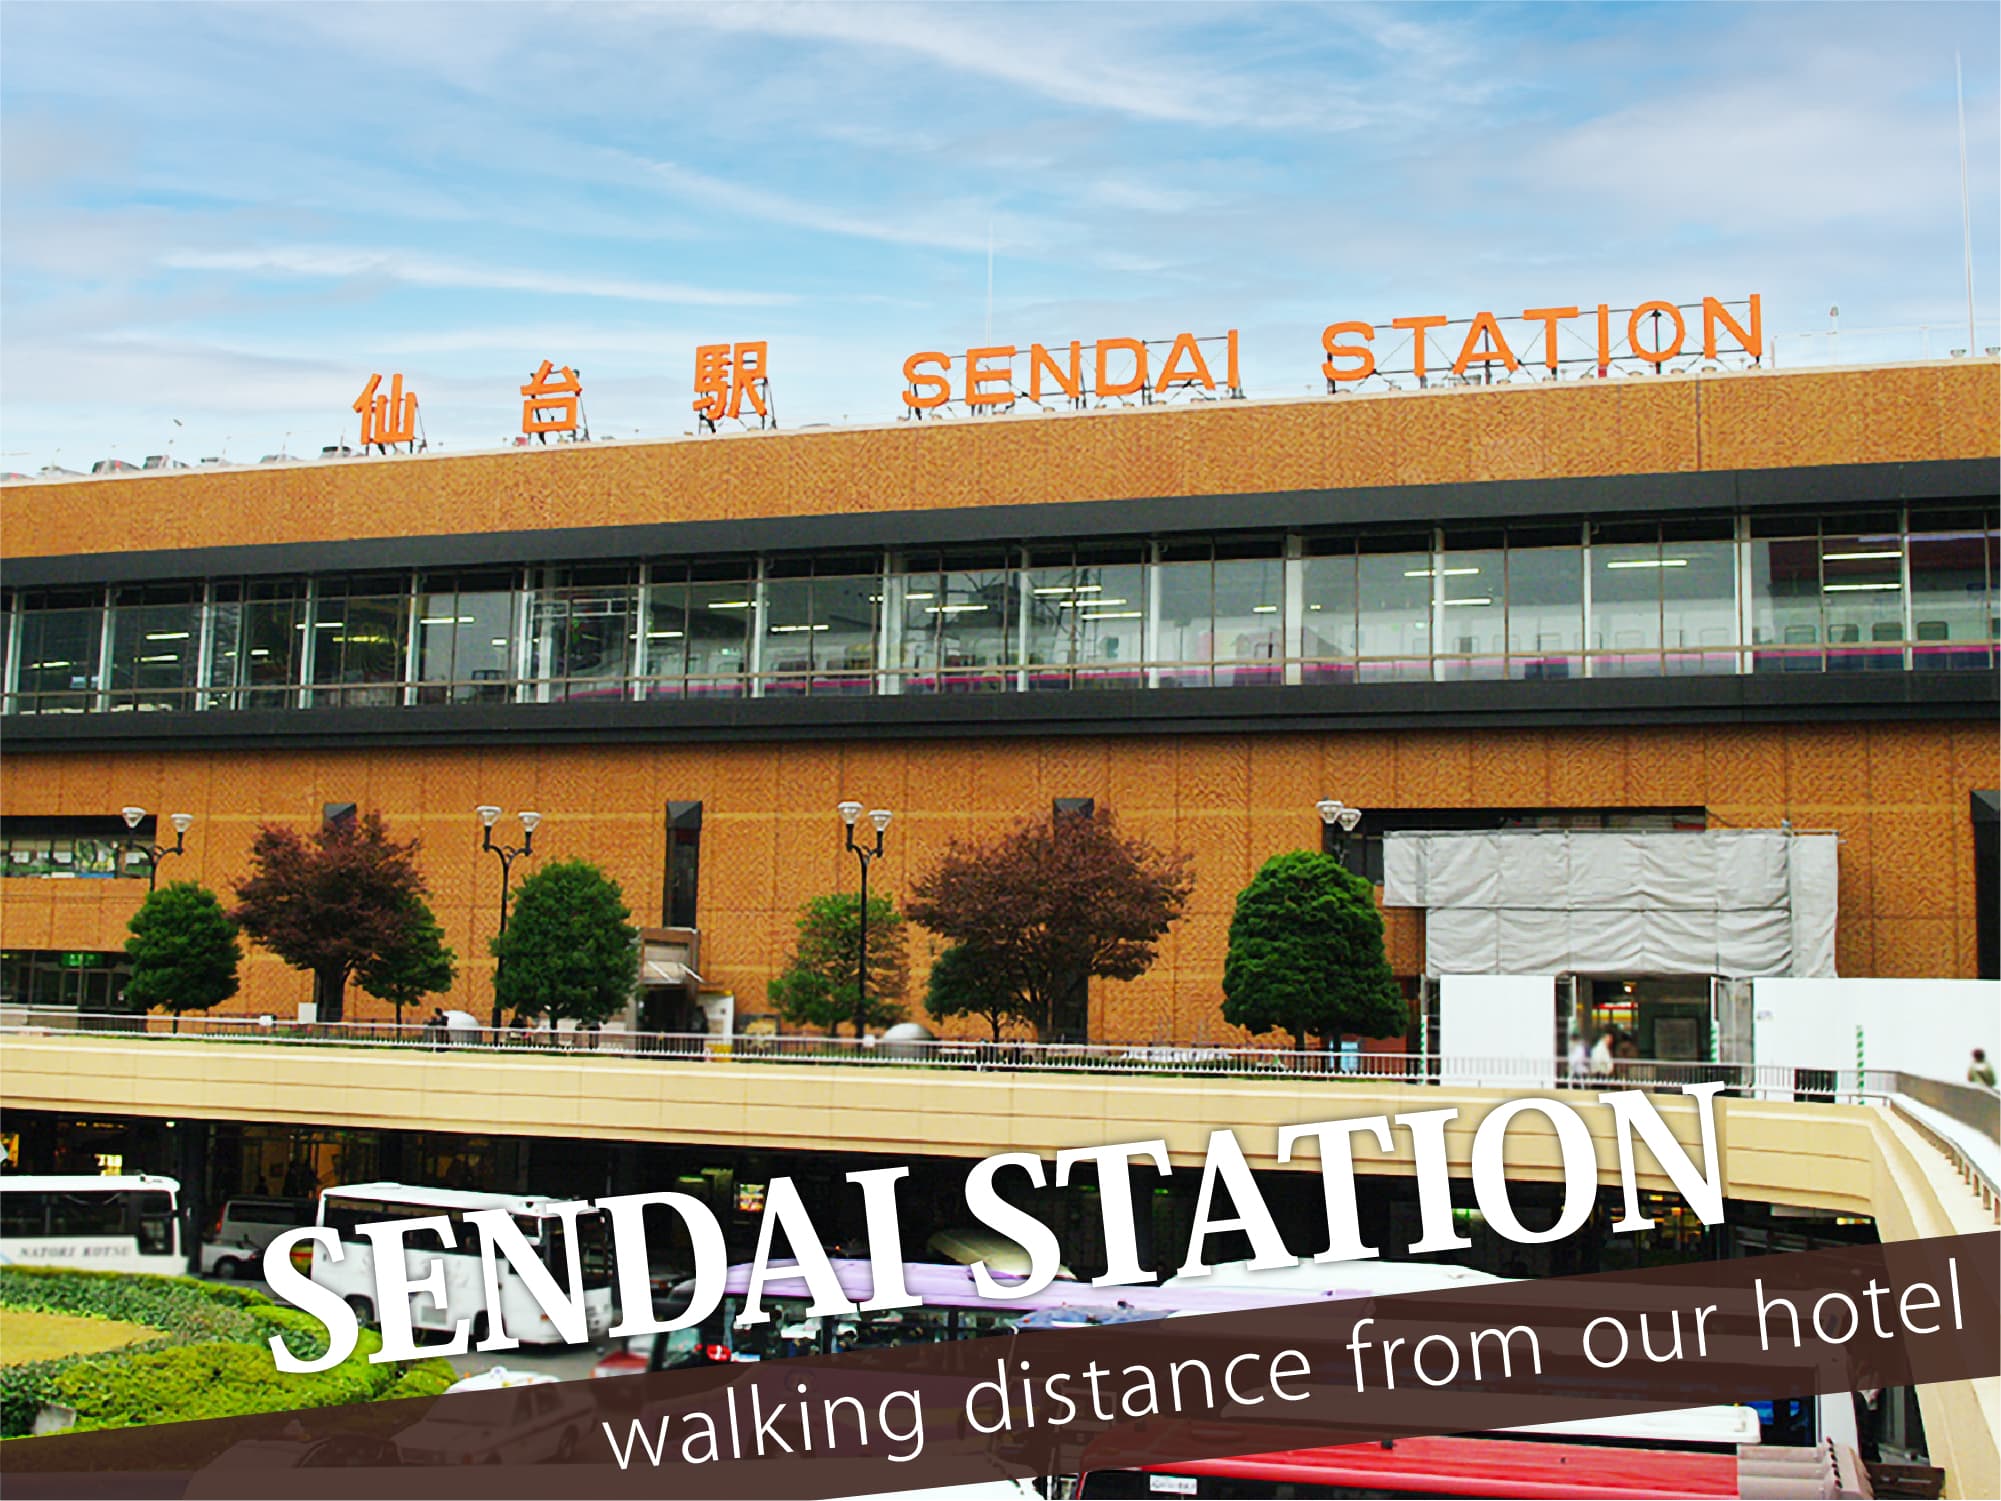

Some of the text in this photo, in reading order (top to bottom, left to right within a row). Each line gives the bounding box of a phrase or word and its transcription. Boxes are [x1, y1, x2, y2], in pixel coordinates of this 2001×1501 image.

[352, 341, 769, 446] 仙台駅
[902, 294, 1762, 409] SENDAI STATION
